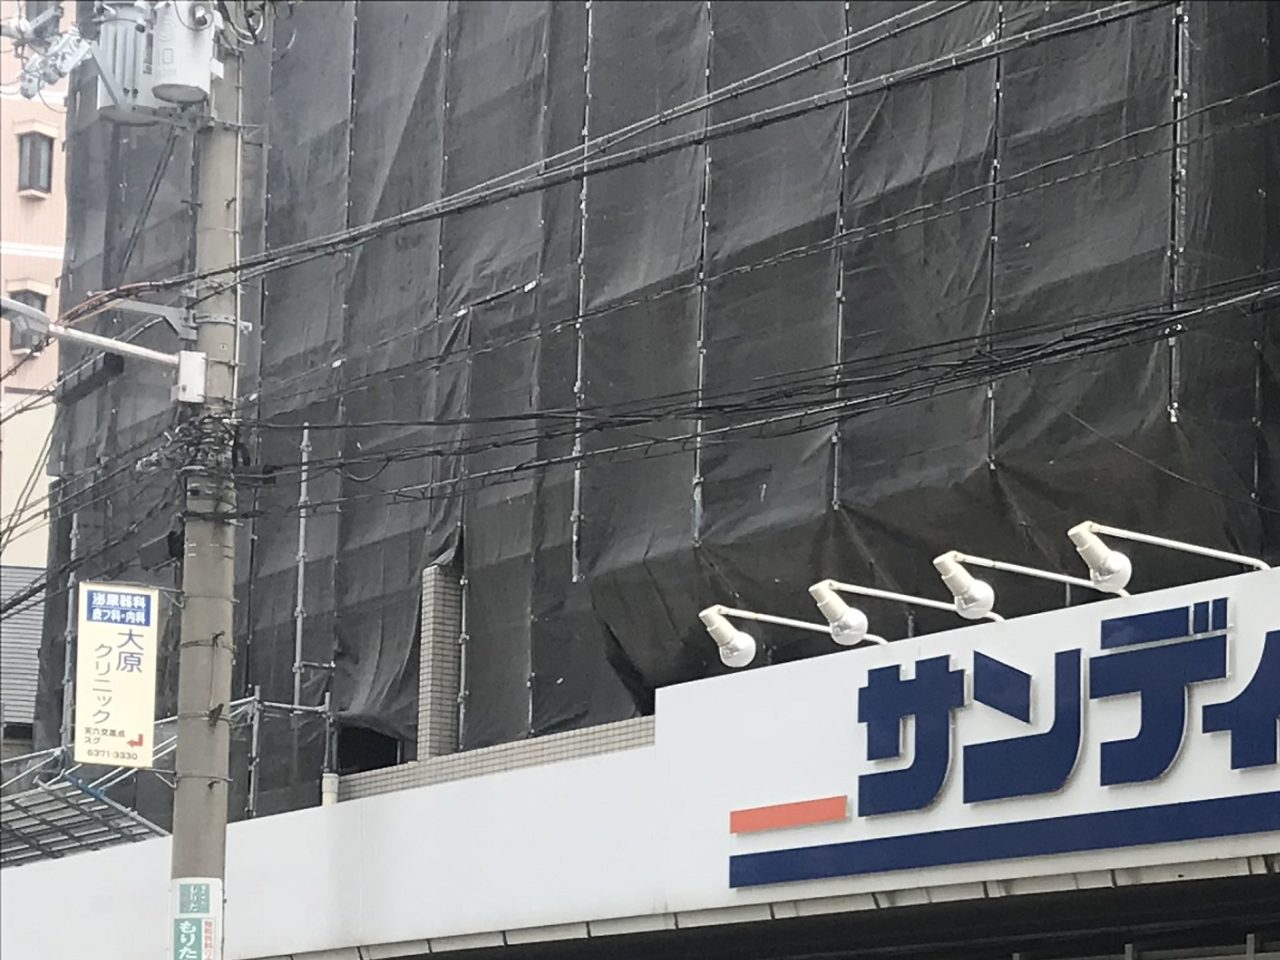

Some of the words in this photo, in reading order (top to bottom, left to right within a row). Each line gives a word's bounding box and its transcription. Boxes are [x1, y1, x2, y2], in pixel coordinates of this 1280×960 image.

[116, 628, 144, 673] 大原
[92, 643, 113, 725] クリニック
[84, 726, 126, 737] 天六交差点
[84, 736, 101, 745] スグ
